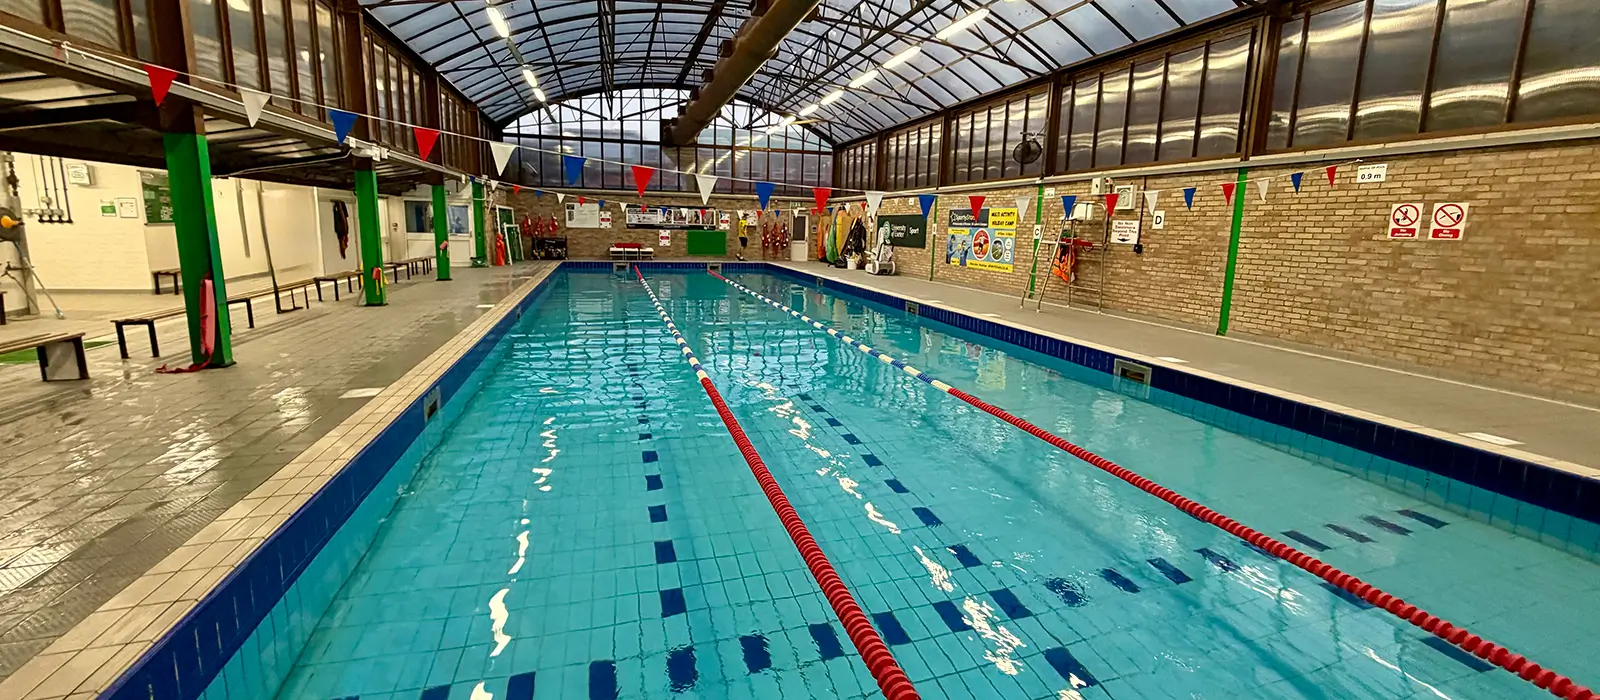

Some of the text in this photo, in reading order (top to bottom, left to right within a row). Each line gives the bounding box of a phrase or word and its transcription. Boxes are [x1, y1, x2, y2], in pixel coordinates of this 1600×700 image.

[1155, 215, 1162, 225] D
[909, 226, 919, 235] Sport
[1034, 228, 1040, 236] C
